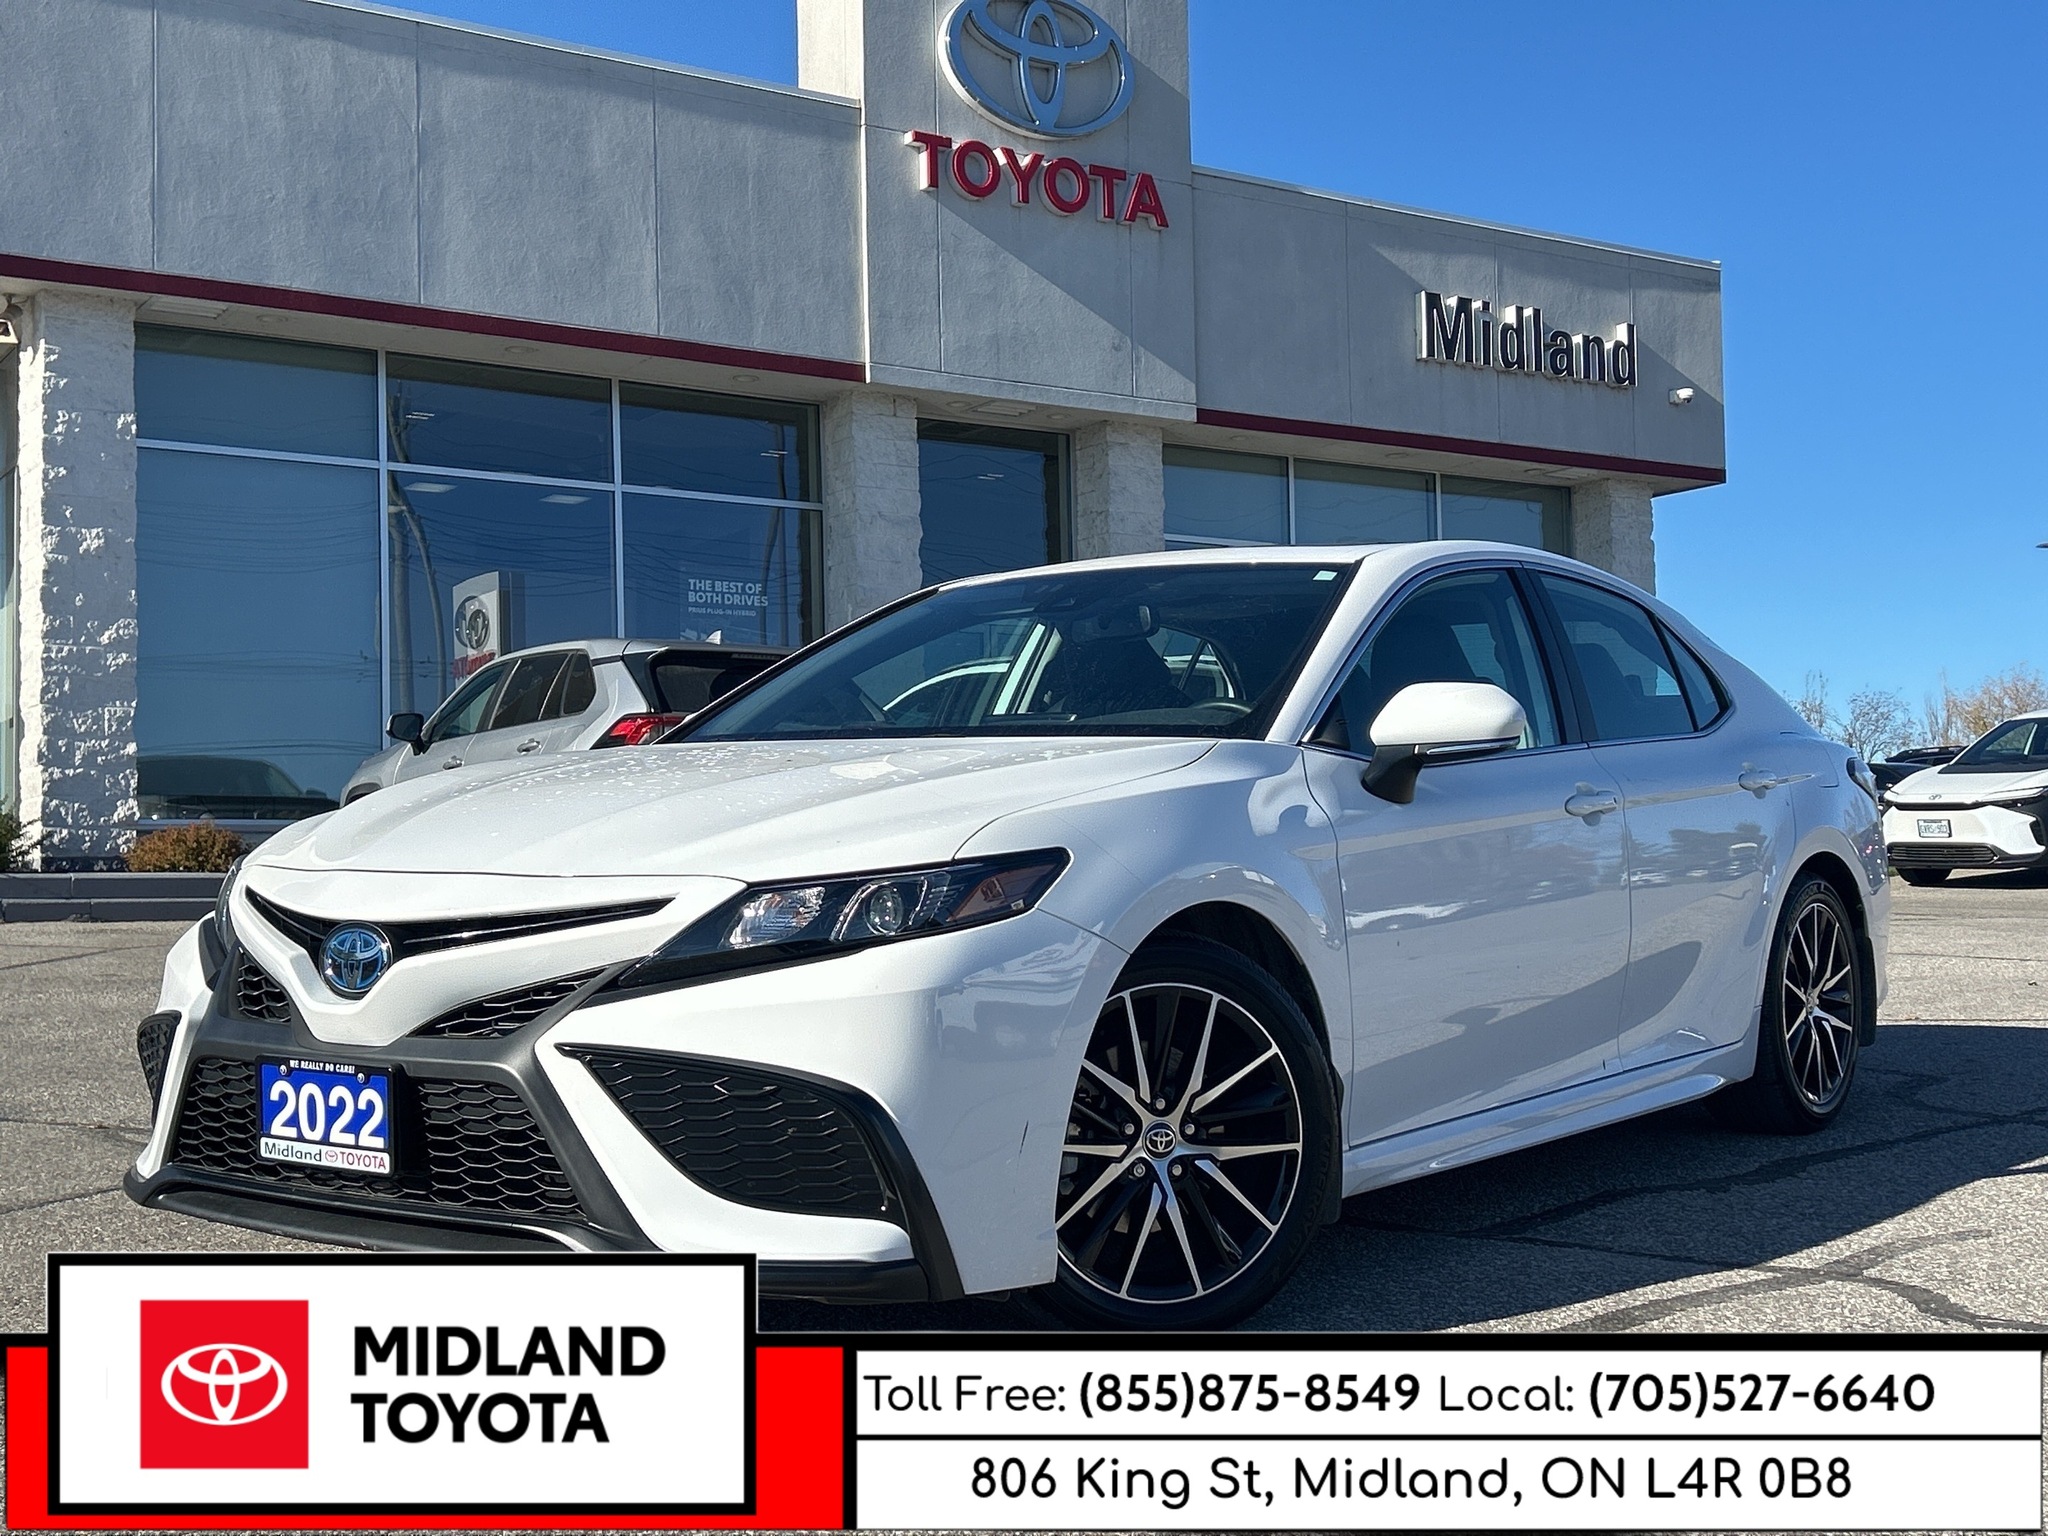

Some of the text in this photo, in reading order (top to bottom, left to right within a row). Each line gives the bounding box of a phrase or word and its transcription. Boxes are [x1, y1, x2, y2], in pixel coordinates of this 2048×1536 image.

[905, 130, 1169, 230] TOYOTA
[1416, 290, 1638, 388] Midland
[688, 579, 762, 594] THE BEST OF
[688, 591, 768, 607] BOTH DRIVES
[707, 607, 732, 615] PLUG-IN
[733, 609, 757, 617] HYBRID
[290, 1060, 355, 1074] WE REALLY DO CARE!
[269, 1079, 385, 1149] 2022
[264, 1141, 386, 1170] Midland TOYOTA
